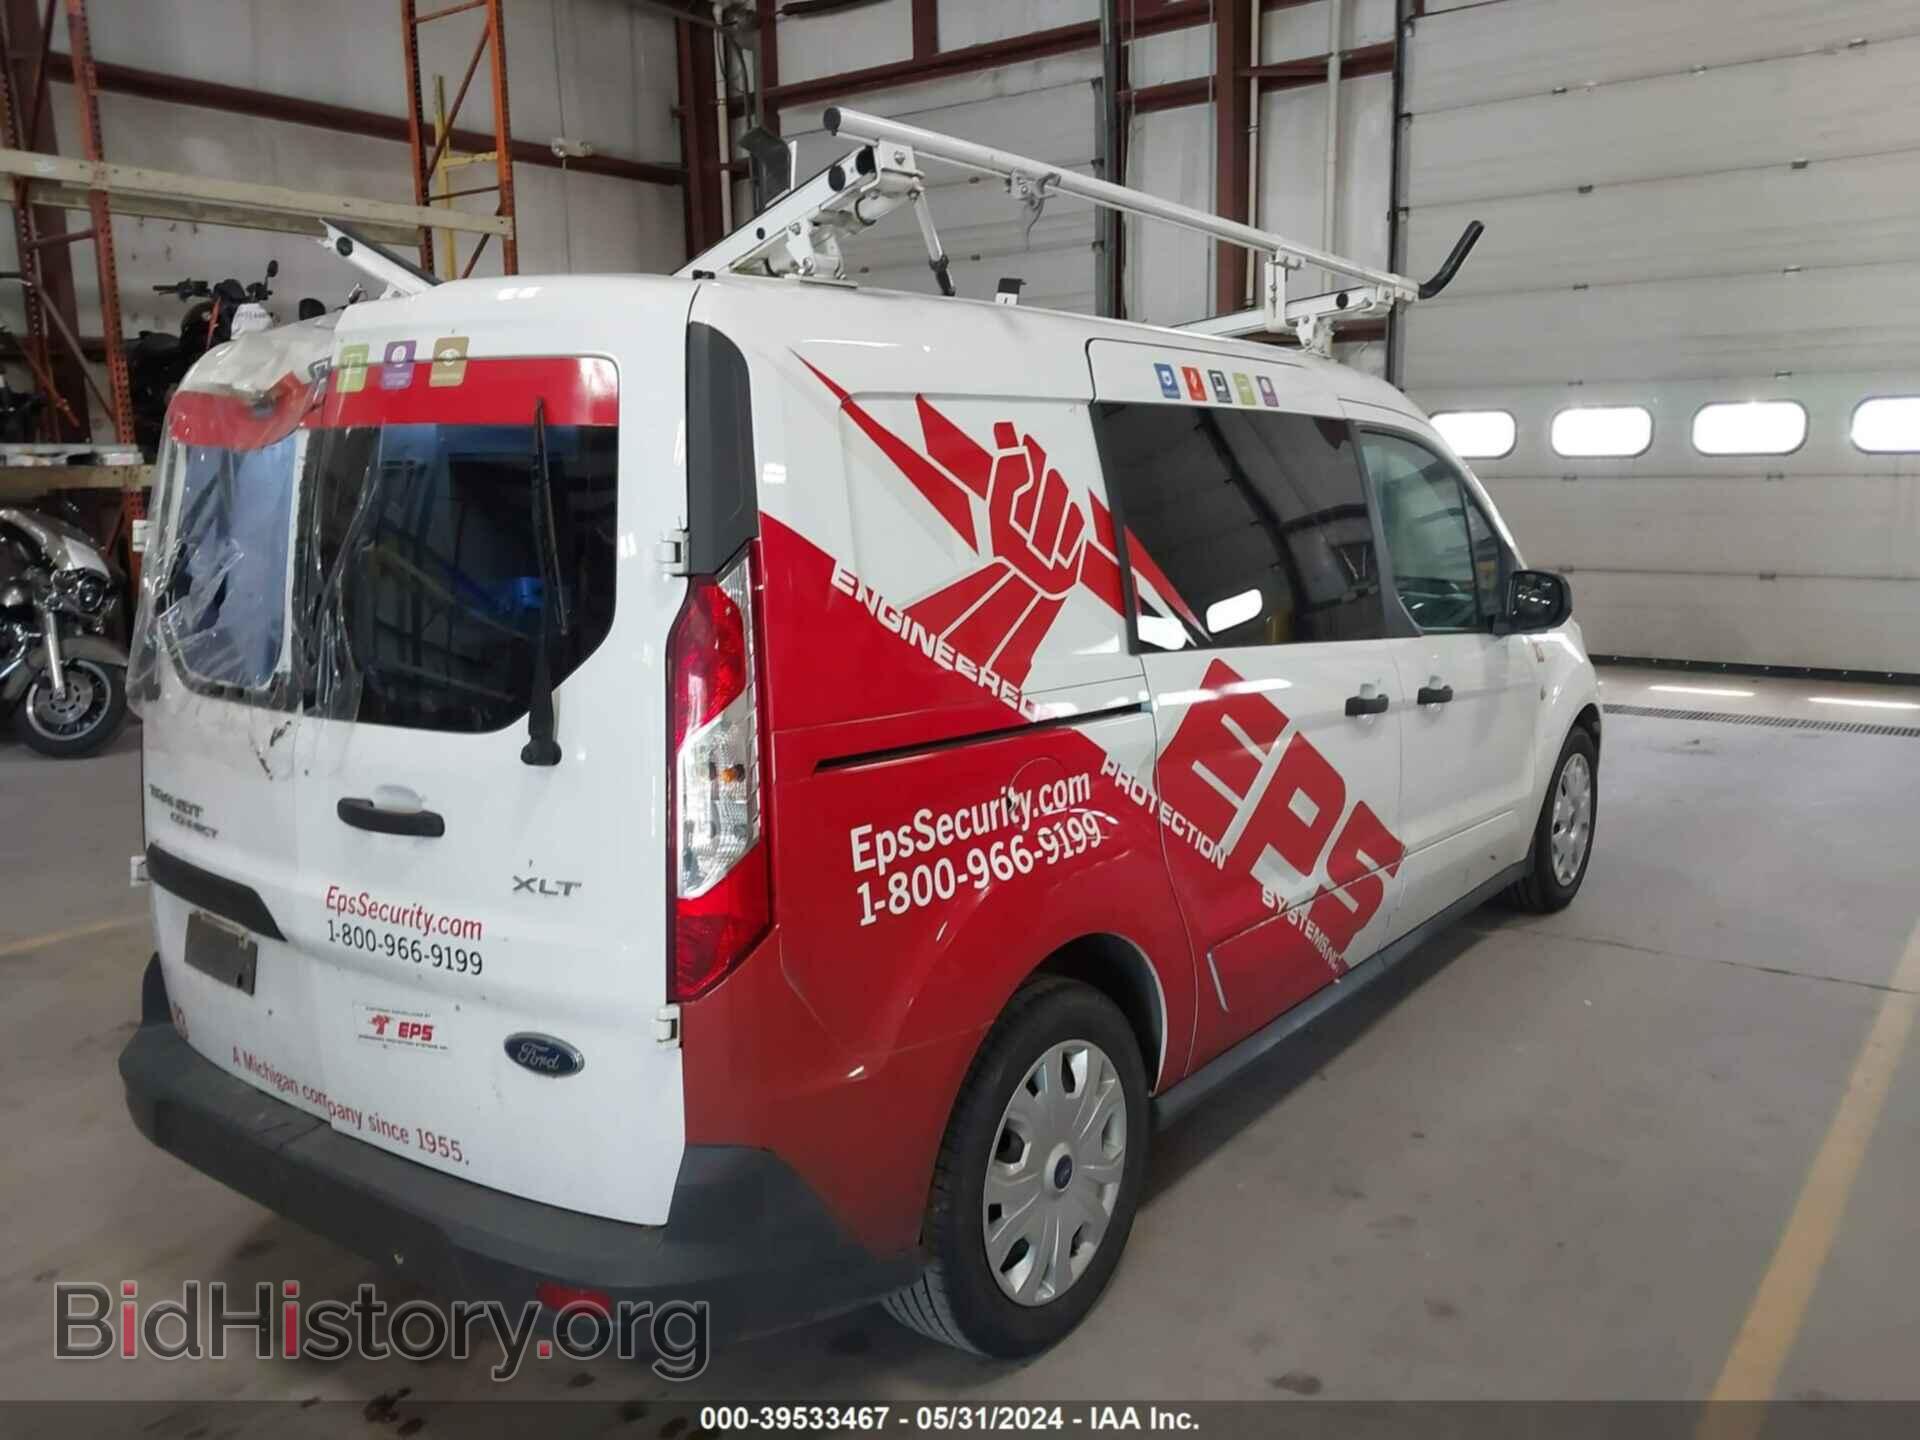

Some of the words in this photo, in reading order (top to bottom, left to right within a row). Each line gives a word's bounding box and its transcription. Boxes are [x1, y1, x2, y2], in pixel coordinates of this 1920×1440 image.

[831, 560, 1041, 723] ENGINEERED
[850, 772, 1091, 876] EpsSecurity.com
[1100, 753, 1227, 870] PROTECTION
[1153, 656, 1407, 957] EPS
[326, 885, 482, 941] EpsSecurity.com
[512, 875, 582, 897] XLT
[857, 811, 1101, 927] 1-800-966-9199
[327, 919, 483, 976] 1-800-966-9199
[398, 1021, 433, 1042] EPS
[518, 1041, 560, 1070] Ford
[233, 1046, 240, 1065] A
[243, 1050, 299, 1097] Michigan
[302, 1085, 362, 1130] company
[368, 1114, 409, 1144] since
[416, 1128, 470, 1165] 1955.
